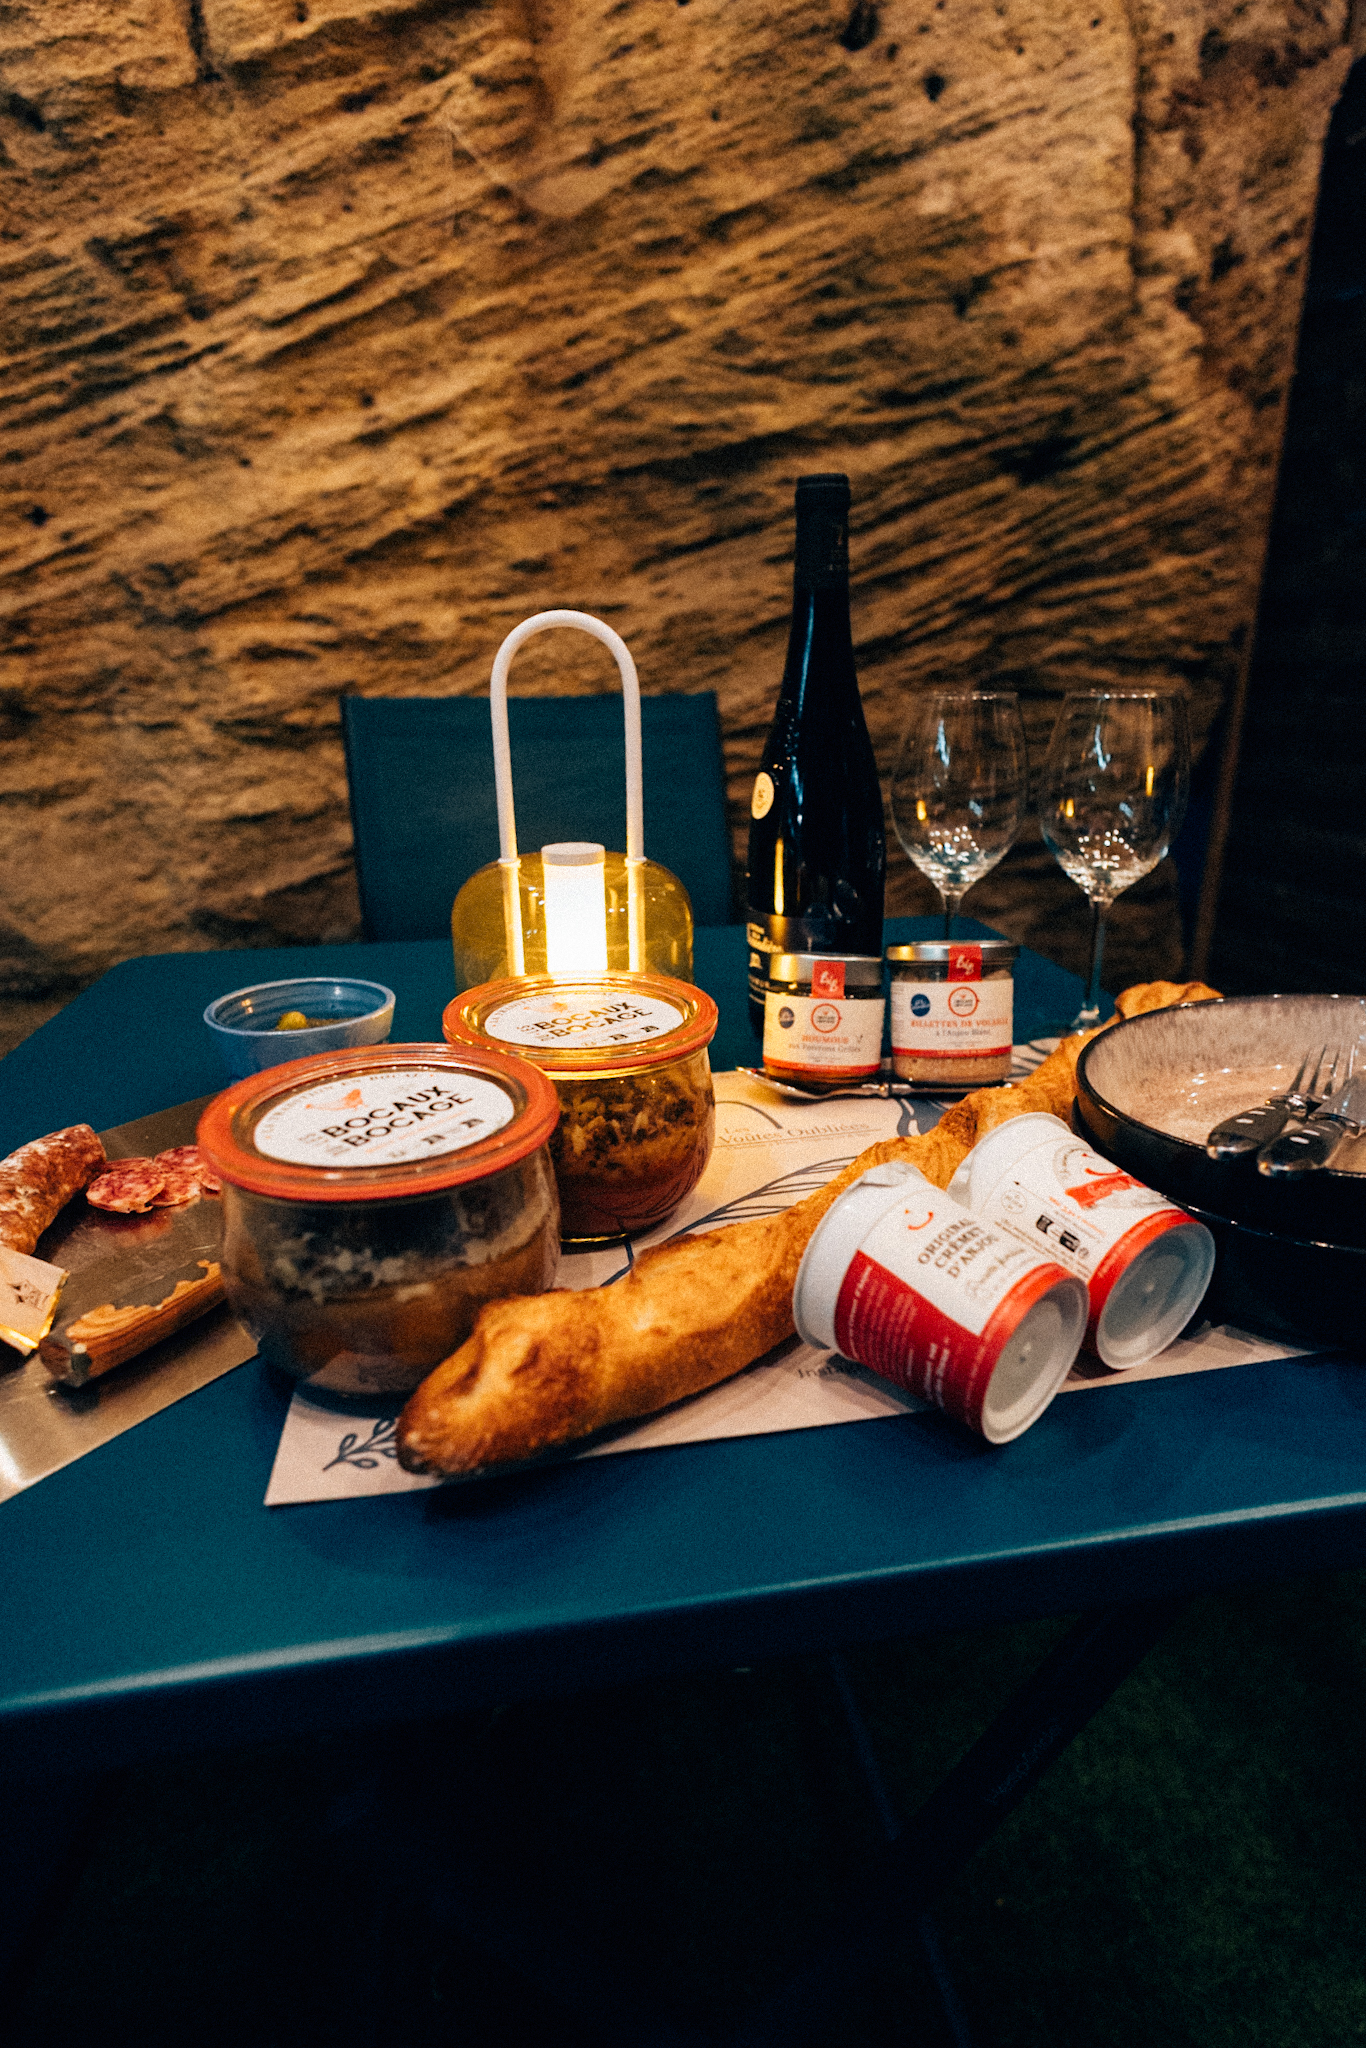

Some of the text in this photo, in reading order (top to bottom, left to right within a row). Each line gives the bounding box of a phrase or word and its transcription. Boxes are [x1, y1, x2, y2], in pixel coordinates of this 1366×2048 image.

[534, 1001, 638, 1031] BOCAUX
[550, 1008, 652, 1038] BOCAGE
[322, 1085, 452, 1139] BOCAUX
[343, 1093, 474, 1147] BOCAGE
[787, 1122, 870, 1138] Oubliées
